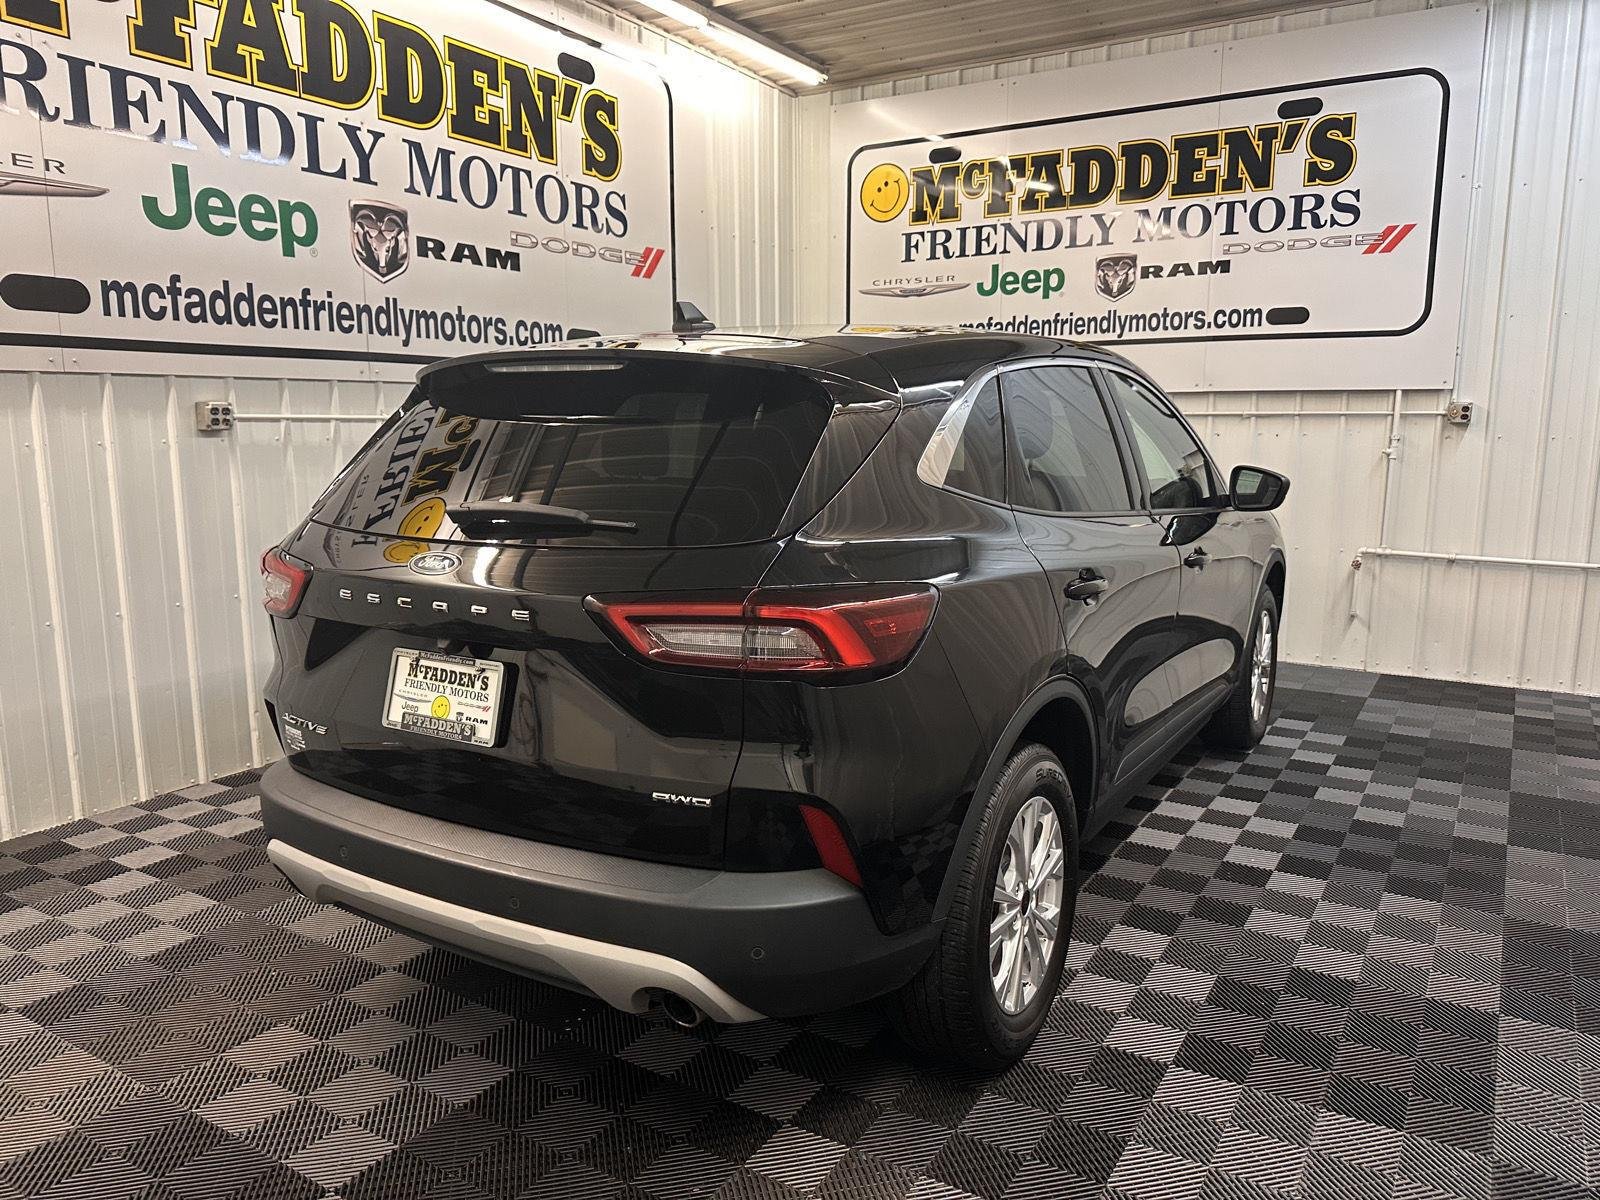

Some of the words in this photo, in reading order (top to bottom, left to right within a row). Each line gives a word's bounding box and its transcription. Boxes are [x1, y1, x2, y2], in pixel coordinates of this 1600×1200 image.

[0, 152, 66, 175] ER
[402, 138, 628, 238] MOTORS
[142, 163, 319, 257] Jeep
[901, 211, 1123, 263] FRIENDLY
[1132, 188, 1361, 245] MOTORS
[416, 236, 521, 272] RAM
[510, 231, 647, 268] DODGE
[1222, 232, 1384, 256] DODGE
[872, 275, 956, 287] CHRYSLER
[1140, 259, 1231, 279] RAM
[976, 264, 1065, 299] Jeep
[100, 274, 563, 348] mcfaddenfriendlymotors.com
[339, 588, 530, 622] ESCAPE
[404, 678, 448, 695] FRIENDLY
[449, 687, 489, 703] MOTORS
[401, 701, 419, 713] Jeep
[282, 712, 328, 735] ACTIVE
[410, 725, 438, 737] FRIENDLY
[438, 730, 462, 740] MOTORS
[465, 716, 488, 725] RAM
[652, 791, 711, 808] AWD
